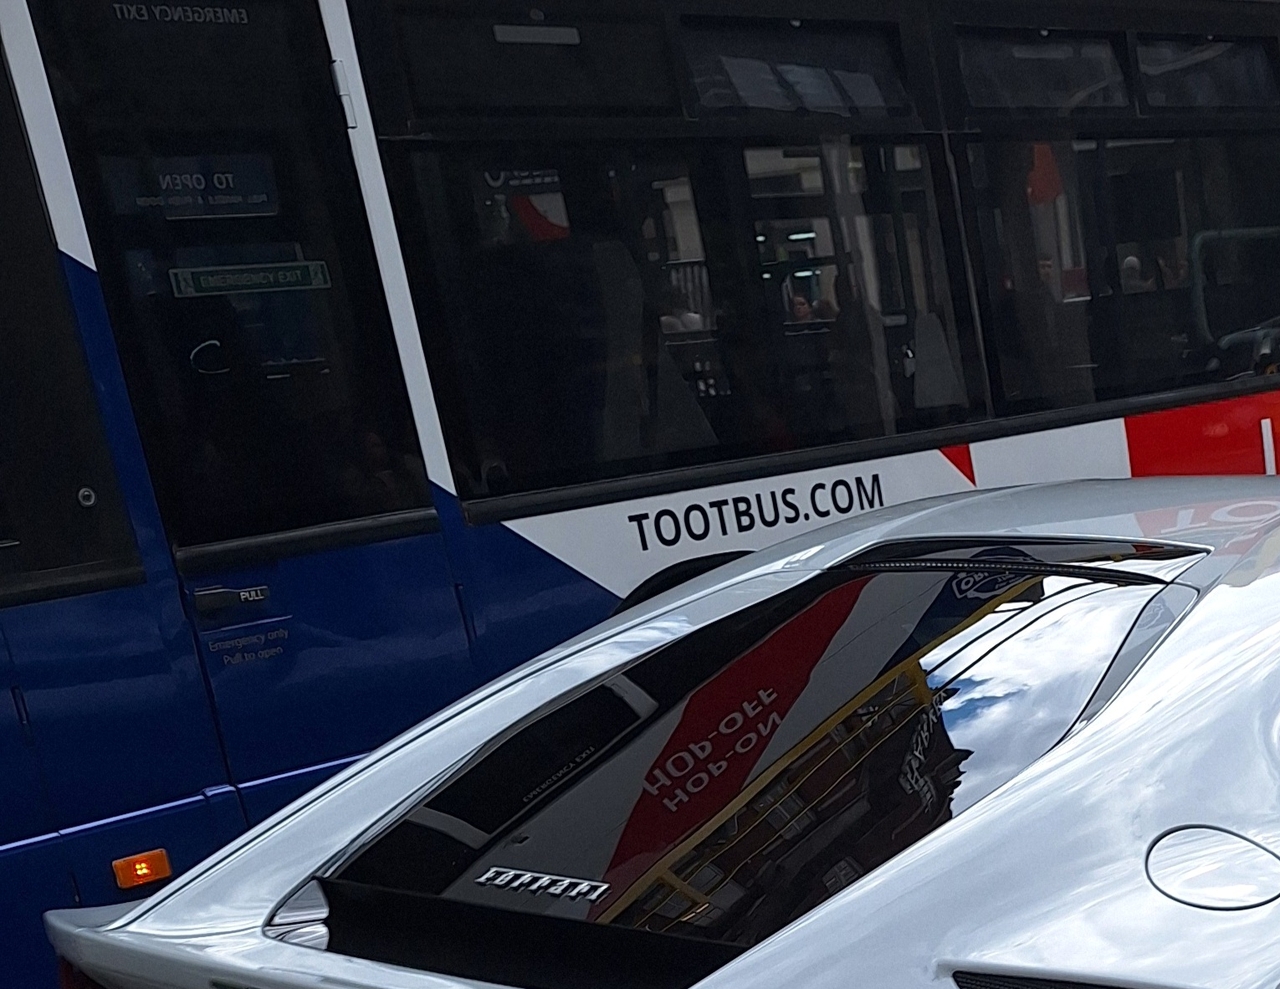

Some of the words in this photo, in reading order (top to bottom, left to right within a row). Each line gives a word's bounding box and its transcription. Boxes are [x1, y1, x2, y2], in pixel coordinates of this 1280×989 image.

[628, 474, 884, 551] TOOTBUS.COM
[240, 590, 265, 601] PULL
[208, 635, 265, 651] Emergency
[244, 652, 256, 661] to
